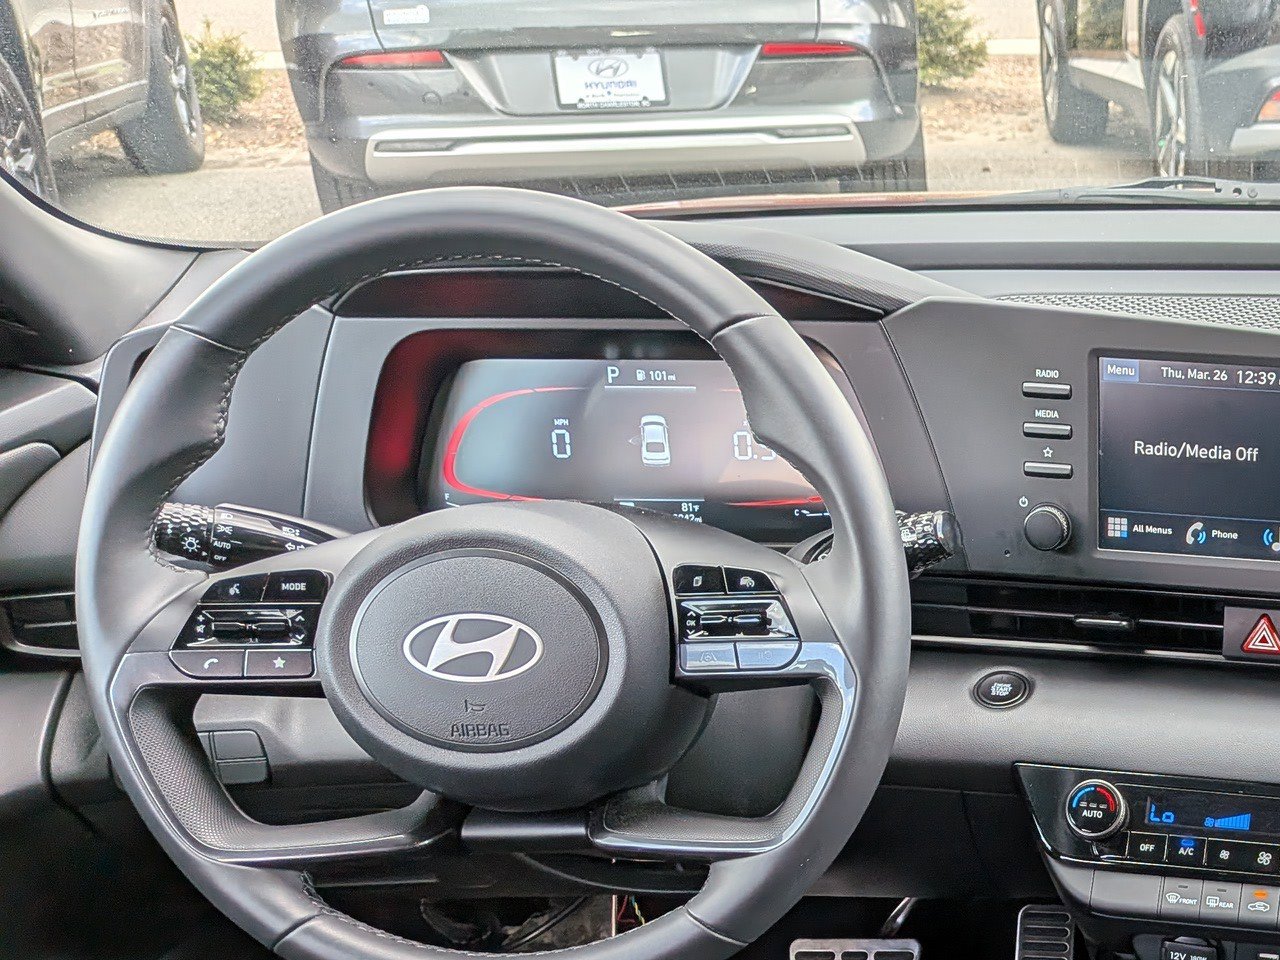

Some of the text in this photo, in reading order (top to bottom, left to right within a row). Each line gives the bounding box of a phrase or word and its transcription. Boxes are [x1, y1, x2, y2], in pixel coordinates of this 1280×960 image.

[607, 366, 619, 384] P
[1035, 369, 1059, 378] RADIO
[1107, 365, 1135, 376] Menu
[1161, 366, 1185, 379] Thu,
[1187, 368, 1211, 380] Mar.
[1213, 370, 1228, 381] 26
[1236, 370, 1277, 385] 12:39
[1035, 409, 1059, 418] MEDIA
[551, 429, 571, 459] 0
[1134, 440, 1259, 462] Radio/Media Off
[1133, 524, 1173, 535] All Menus
[1211, 530, 1238, 540] Phone
[213, 540, 231, 550] AUTO
[281, 583, 306, 591] MODE
[450, 723, 509, 737] AIRBAG
[1082, 809, 1103, 818] AUTO
[1140, 844, 1155, 852] OFF
[1178, 847, 1194, 856] A/C
[1179, 897, 1198, 905] FRONT
[1218, 901, 1233, 909] REAR
